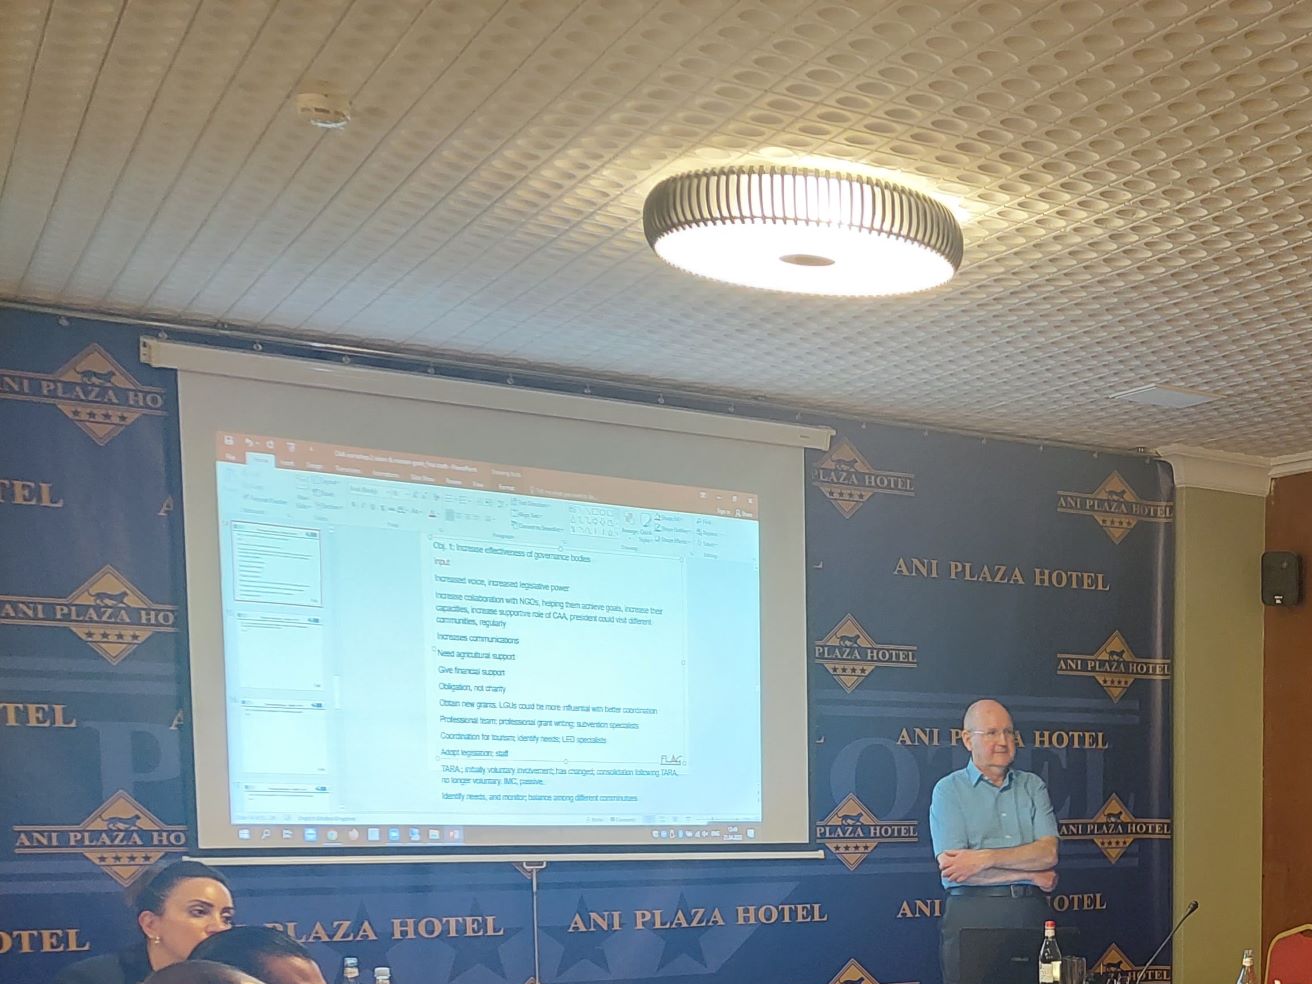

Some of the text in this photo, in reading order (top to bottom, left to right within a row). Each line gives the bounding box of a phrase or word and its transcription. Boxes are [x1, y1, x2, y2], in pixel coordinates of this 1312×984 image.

[40, 380, 118, 403] PLAZA
[812, 469, 914, 491] PLAZA HOTEL
[1058, 496, 1173, 518] ANI PLAZA HOTEL
[456, 544, 483, 553] Increase
[484, 546, 525, 557] effectiveness
[533, 551, 569, 561] governance
[570, 553, 592, 563] bodies
[893, 557, 1110, 591] ANI PLAZA HOTEL
[434, 574, 467, 584] Increased
[550, 584, 570, 593] power
[435, 591, 463, 600] Increase
[1, 603, 44, 619] ANI
[55, 606, 131, 623] PLAZA
[468, 634, 520, 644] communications
[437, 649, 515, 662] Need agricultural support
[815, 646, 917, 662] PLAZA HOTEL
[438, 666, 505, 677] Give financial support
[1058, 658, 1171, 675] ANI PLAZA HOTEL
[473, 684, 484, 692] not
[518, 702, 535, 710] could
[440, 715, 479, 724] Professional
[896, 727, 939, 747] ANI
[1033, 730, 1109, 750] HOTEL
[816, 825, 918, 838] PLAZA HOTEL
[1060, 822, 1171, 835] ANI PLAZA HOTEL
[15, 832, 58, 846] ANI
[69, 832, 143, 847] PLAZA
[896, 899, 941, 919] ANI
[391, 914, 505, 939] HOTEL
[568, 903, 828, 933] ANI PLAZA HOTEL
